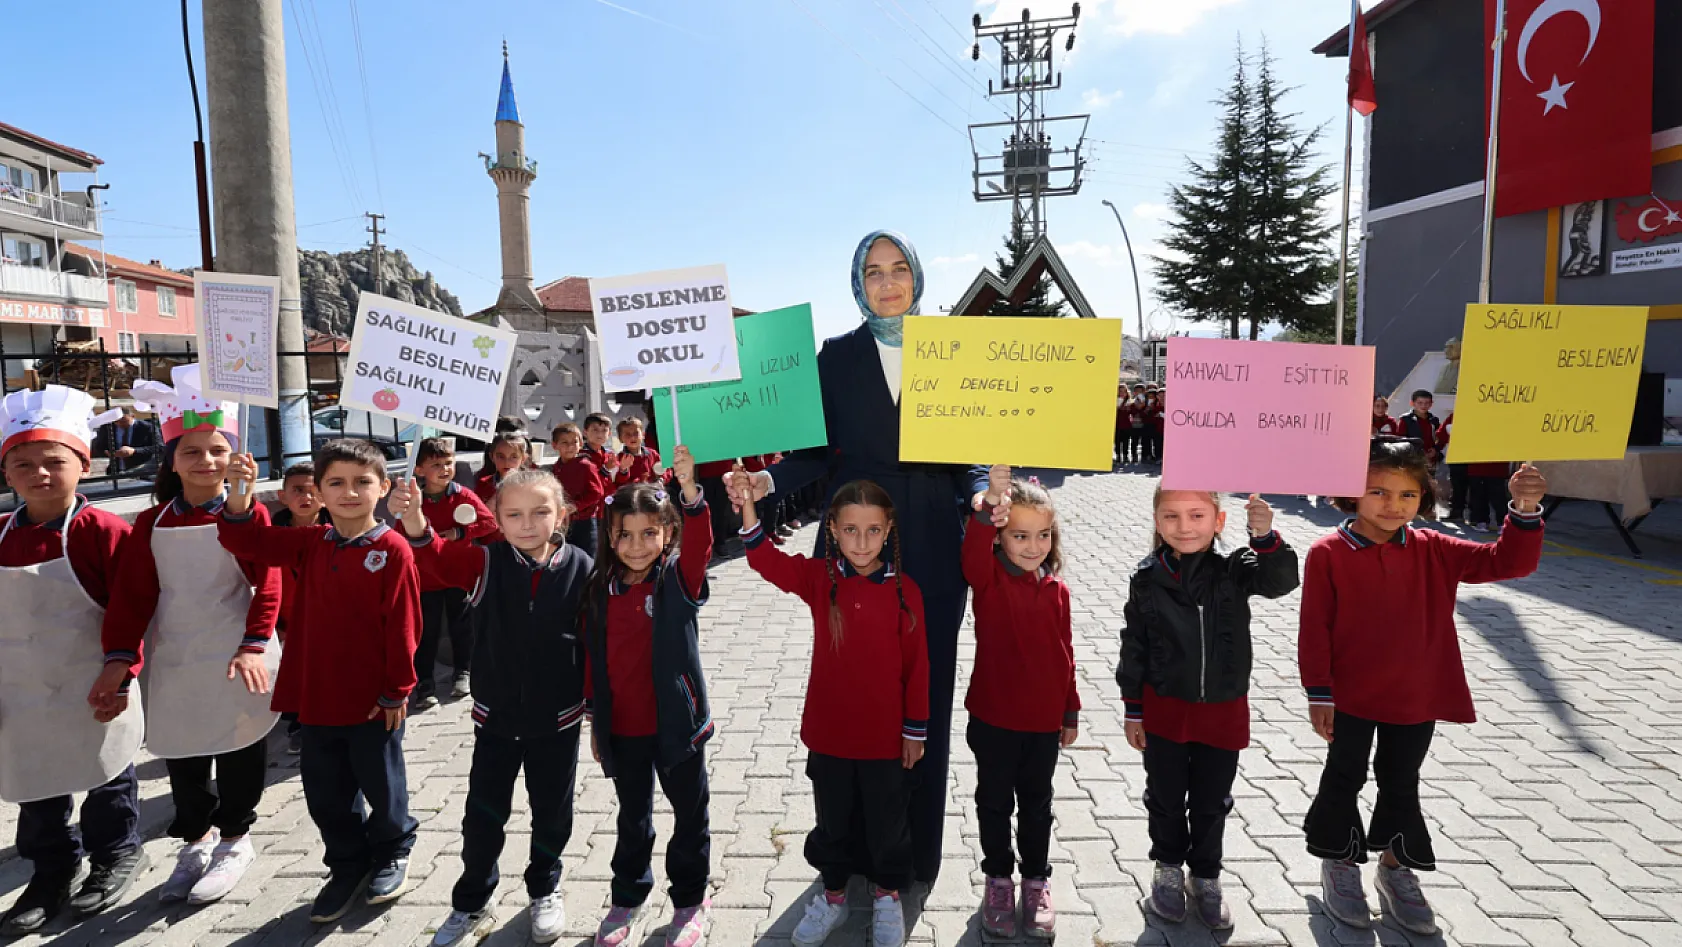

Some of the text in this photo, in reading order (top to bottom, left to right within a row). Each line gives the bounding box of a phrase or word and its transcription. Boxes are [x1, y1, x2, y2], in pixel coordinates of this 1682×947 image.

[1645, 250, 1655, 258] En
[599, 284, 726, 313] BESLENME
[27, 304, 84, 322] MARKET
[1484, 308, 1562, 330] SAĞLIKLI
[365, 309, 457, 346] SAĞLIKLI
[626, 315, 707, 339] DOSTU
[637, 344, 704, 365] OKUL
[915, 340, 1077, 362] KALP SAĞLIĞINIZ
[1557, 345, 1640, 368] BESLENEN
[398, 345, 502, 385] BESLENEN
[760, 352, 799, 375] UZUN
[1173, 360, 1349, 386] KAHVALTI EŞİTTİR
[355, 361, 446, 396] SAĞLIKLI
[960, 375, 1019, 393] DENGELİ
[713, 391, 751, 414] YAŞA
[1478, 382, 1538, 404] SAĞLIKLI
[423, 405, 491, 433] BÜYÜR
[1171, 409, 1236, 429] OKULDA
[1258, 412, 1307, 430] BAŞARI
